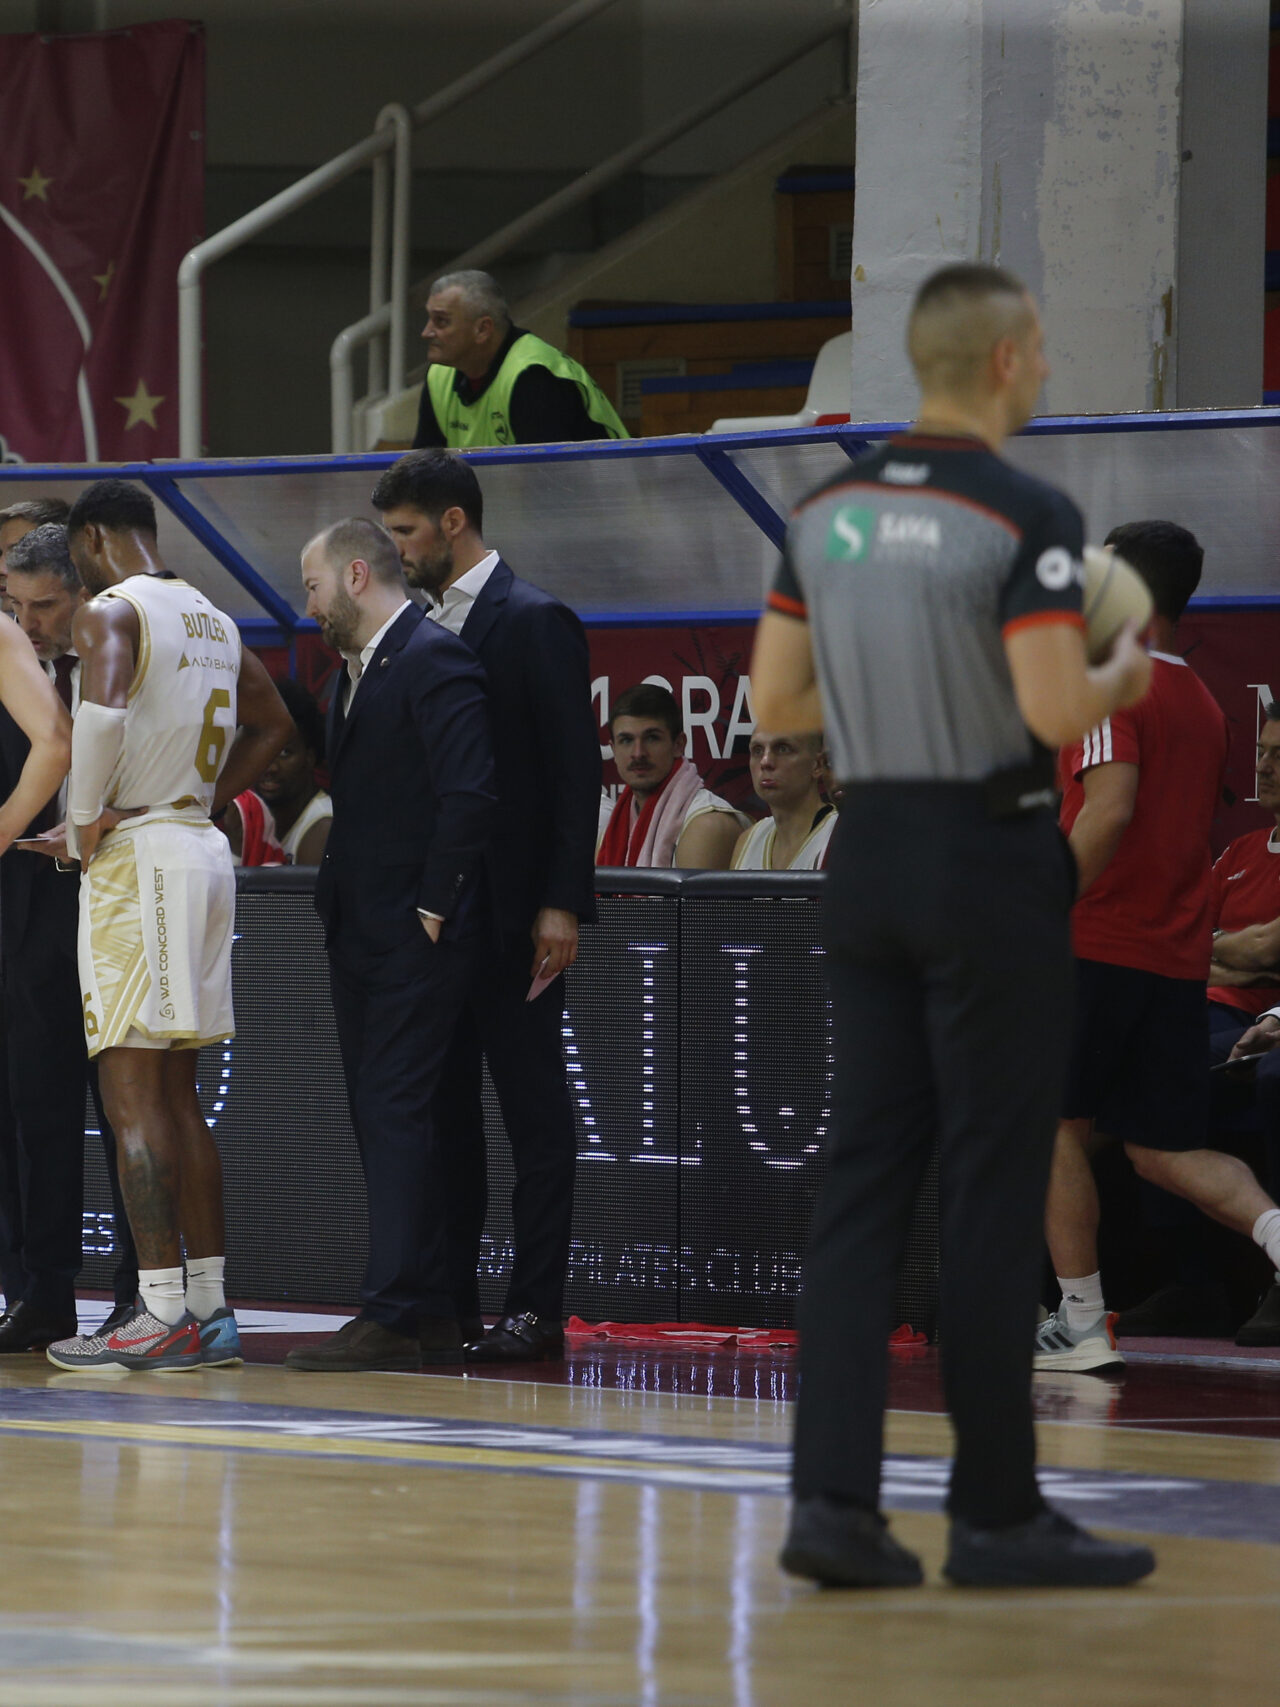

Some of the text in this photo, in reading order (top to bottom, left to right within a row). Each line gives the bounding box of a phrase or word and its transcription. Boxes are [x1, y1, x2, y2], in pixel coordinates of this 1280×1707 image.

[180, 612, 229, 645] BUTLER
[194, 688, 231, 784] 6
[153, 866, 165, 904] WEST
[156, 906, 169, 972] CONCORD
